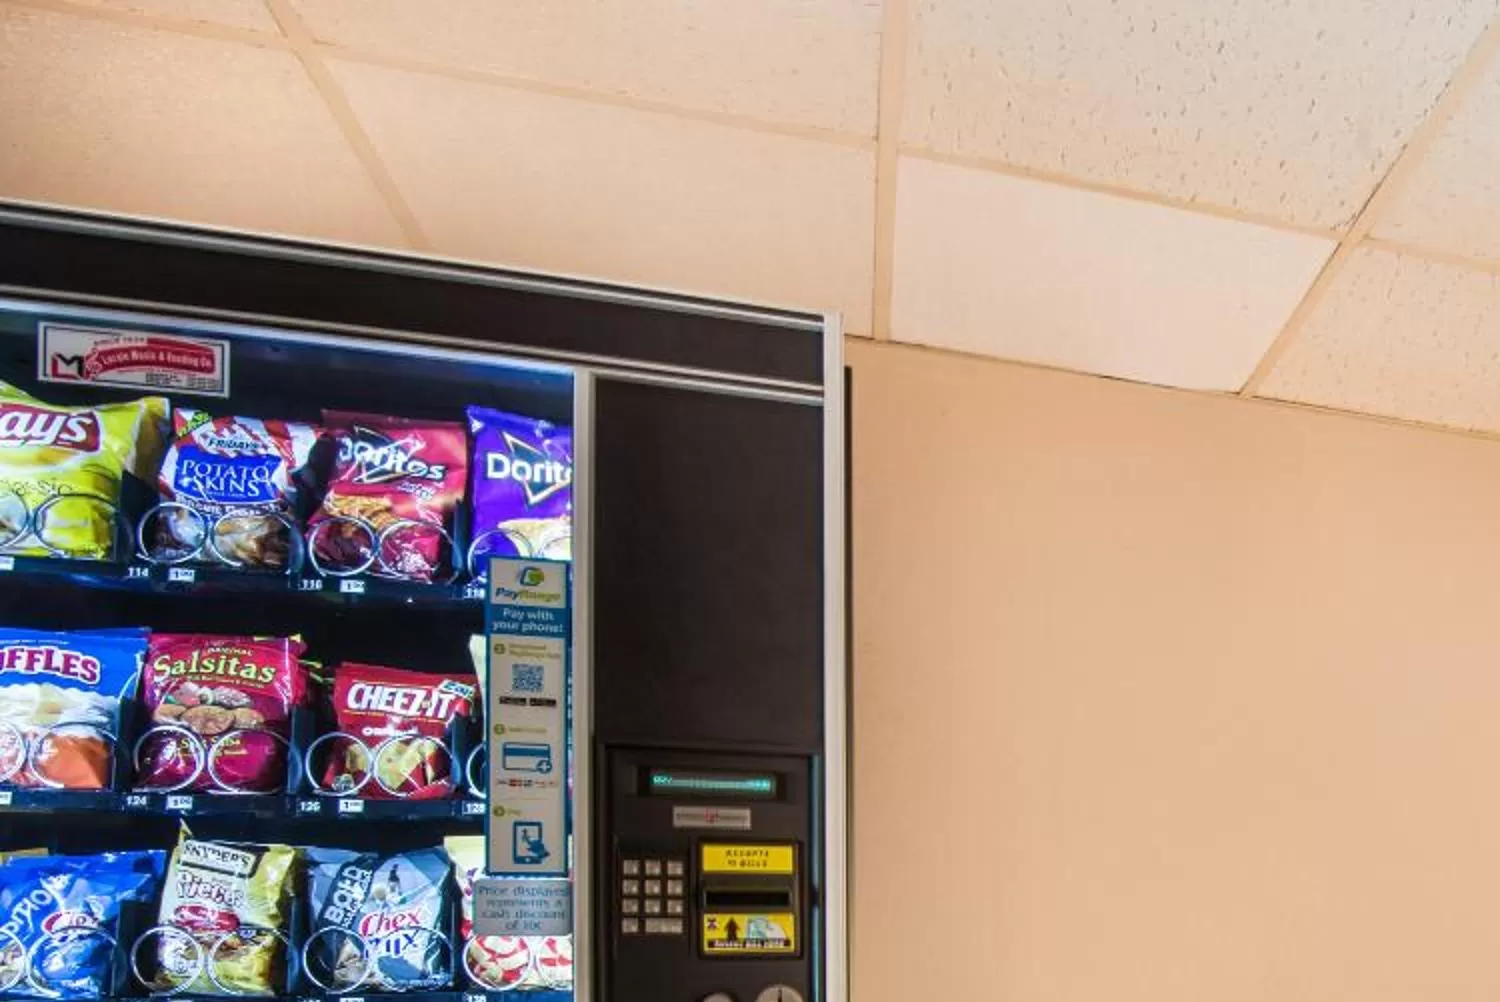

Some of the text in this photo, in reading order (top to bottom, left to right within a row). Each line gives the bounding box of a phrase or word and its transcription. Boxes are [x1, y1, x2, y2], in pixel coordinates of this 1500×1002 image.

[0, 411, 93, 444] ays
[181, 459, 269, 484] POTATO
[486, 453, 572, 483] Dorit
[191, 474, 260, 497] SKINS
[493, 622, 519, 631] your
[503, 608, 554, 621] Pay with
[153, 651, 276, 683] Salsitas
[324, 865, 364, 923] BOLD
[360, 908, 421, 936] Chex
